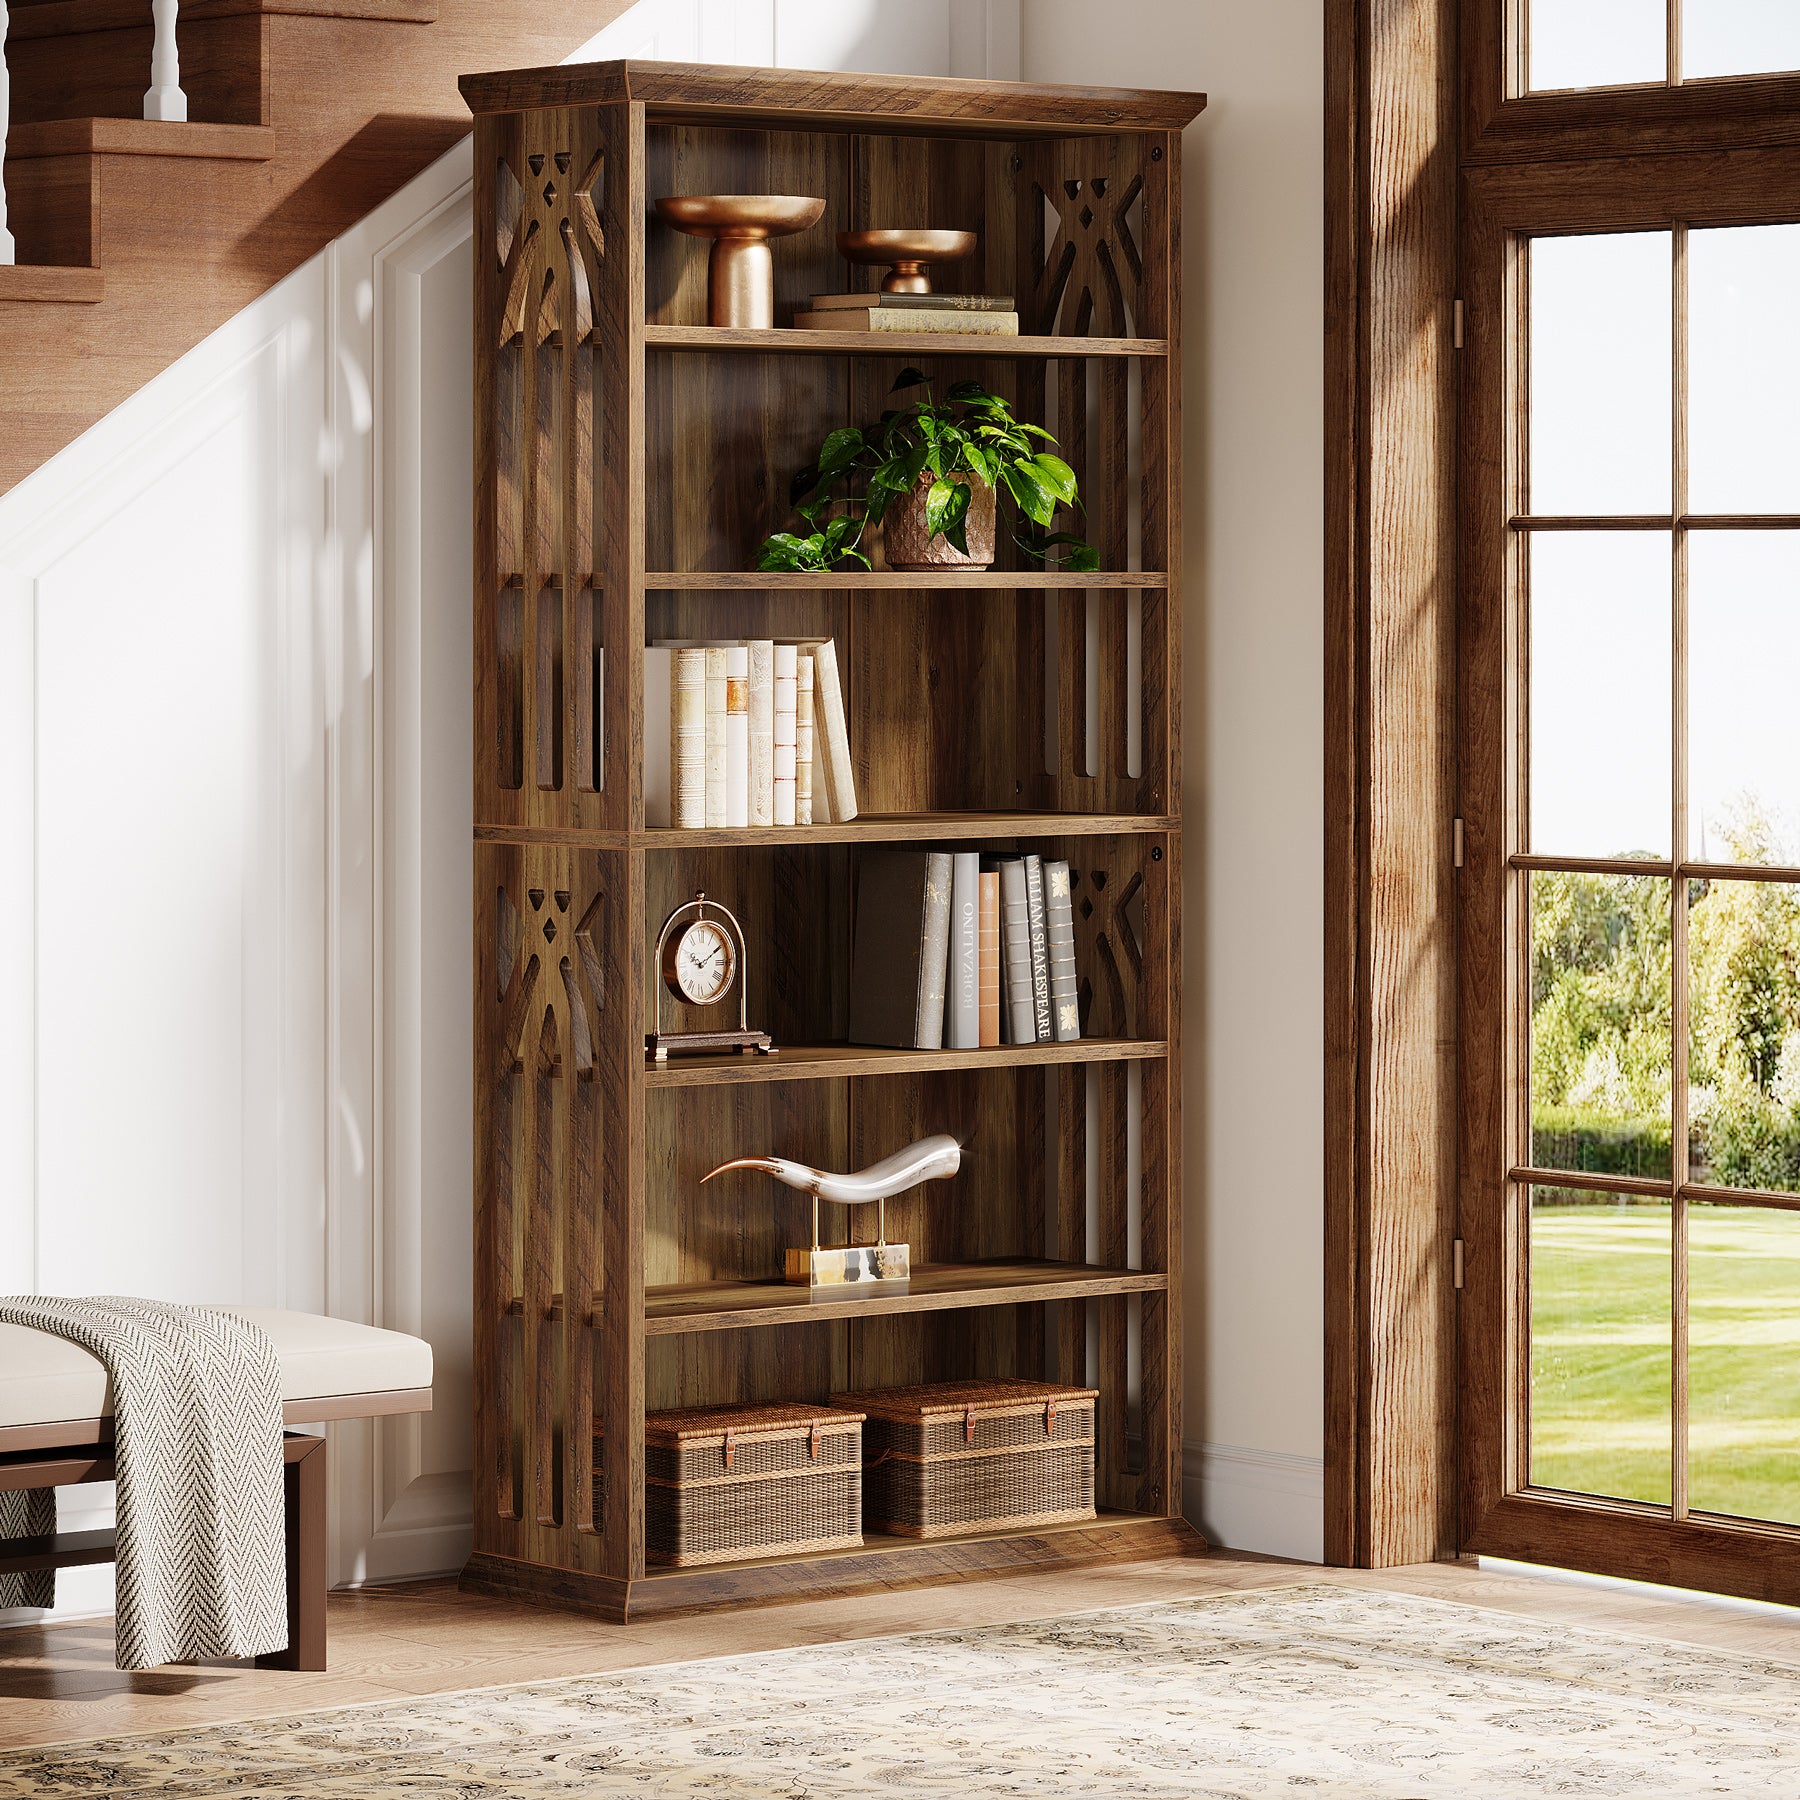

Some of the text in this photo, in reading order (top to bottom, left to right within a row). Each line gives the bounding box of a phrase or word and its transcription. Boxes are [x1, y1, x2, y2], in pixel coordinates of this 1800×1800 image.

[962, 902, 974, 1008] BORZALINO
[1028, 858, 1051, 1038] WILLIAM SHAKESPEARE
